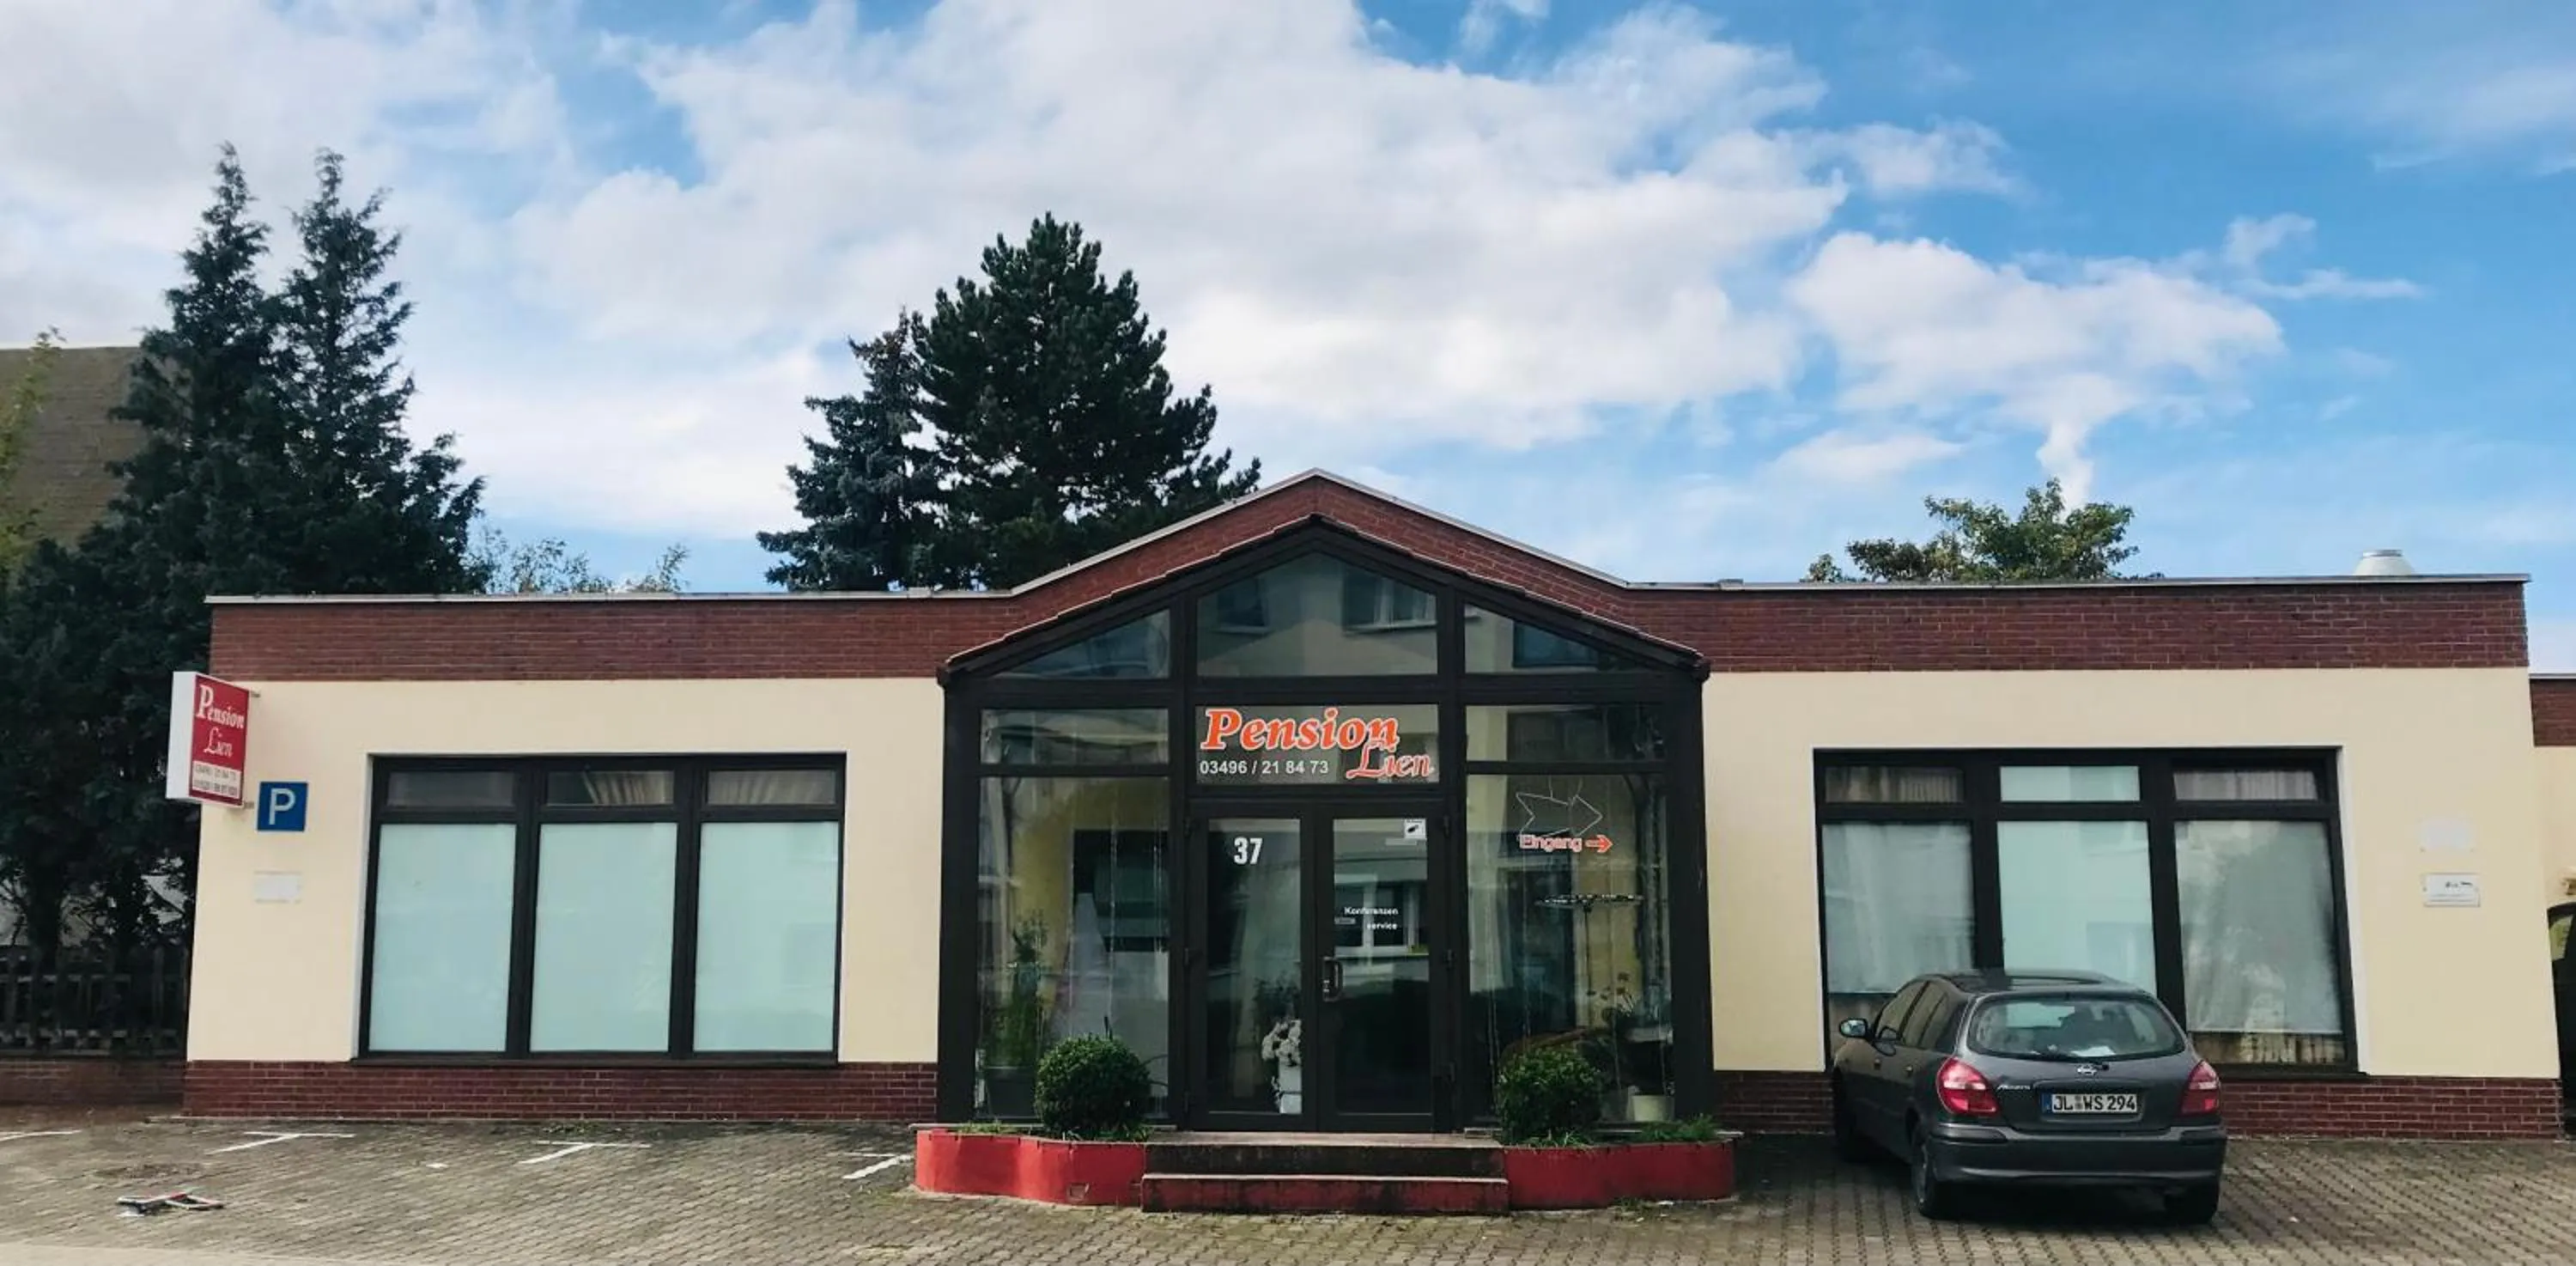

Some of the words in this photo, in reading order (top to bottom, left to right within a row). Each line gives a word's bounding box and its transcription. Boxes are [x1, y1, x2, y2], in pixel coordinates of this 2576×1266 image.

[196, 685, 245, 729] Pension
[203, 727, 234, 758] Lien
[1200, 707, 1400, 752] Pension
[1200, 760, 1248, 774] 03496
[1252, 760, 1257, 774] /
[1261, 760, 1279, 774] 21
[1285, 760, 1304, 774] 84
[1310, 760, 1329, 774] 73
[1346, 740, 1432, 779] Lien
[269, 788, 296, 825] P
[1234, 837, 1263, 865] 37
[1520, 834, 1583, 853] Eingang
[1344, 906, 1399, 915] Konferenzen
[1366, 922, 1398, 930] service
[2053, 1095, 2074, 1111] JL
[2083, 1095, 2104, 1111] WS
[2107, 1095, 2136, 1111] 294
